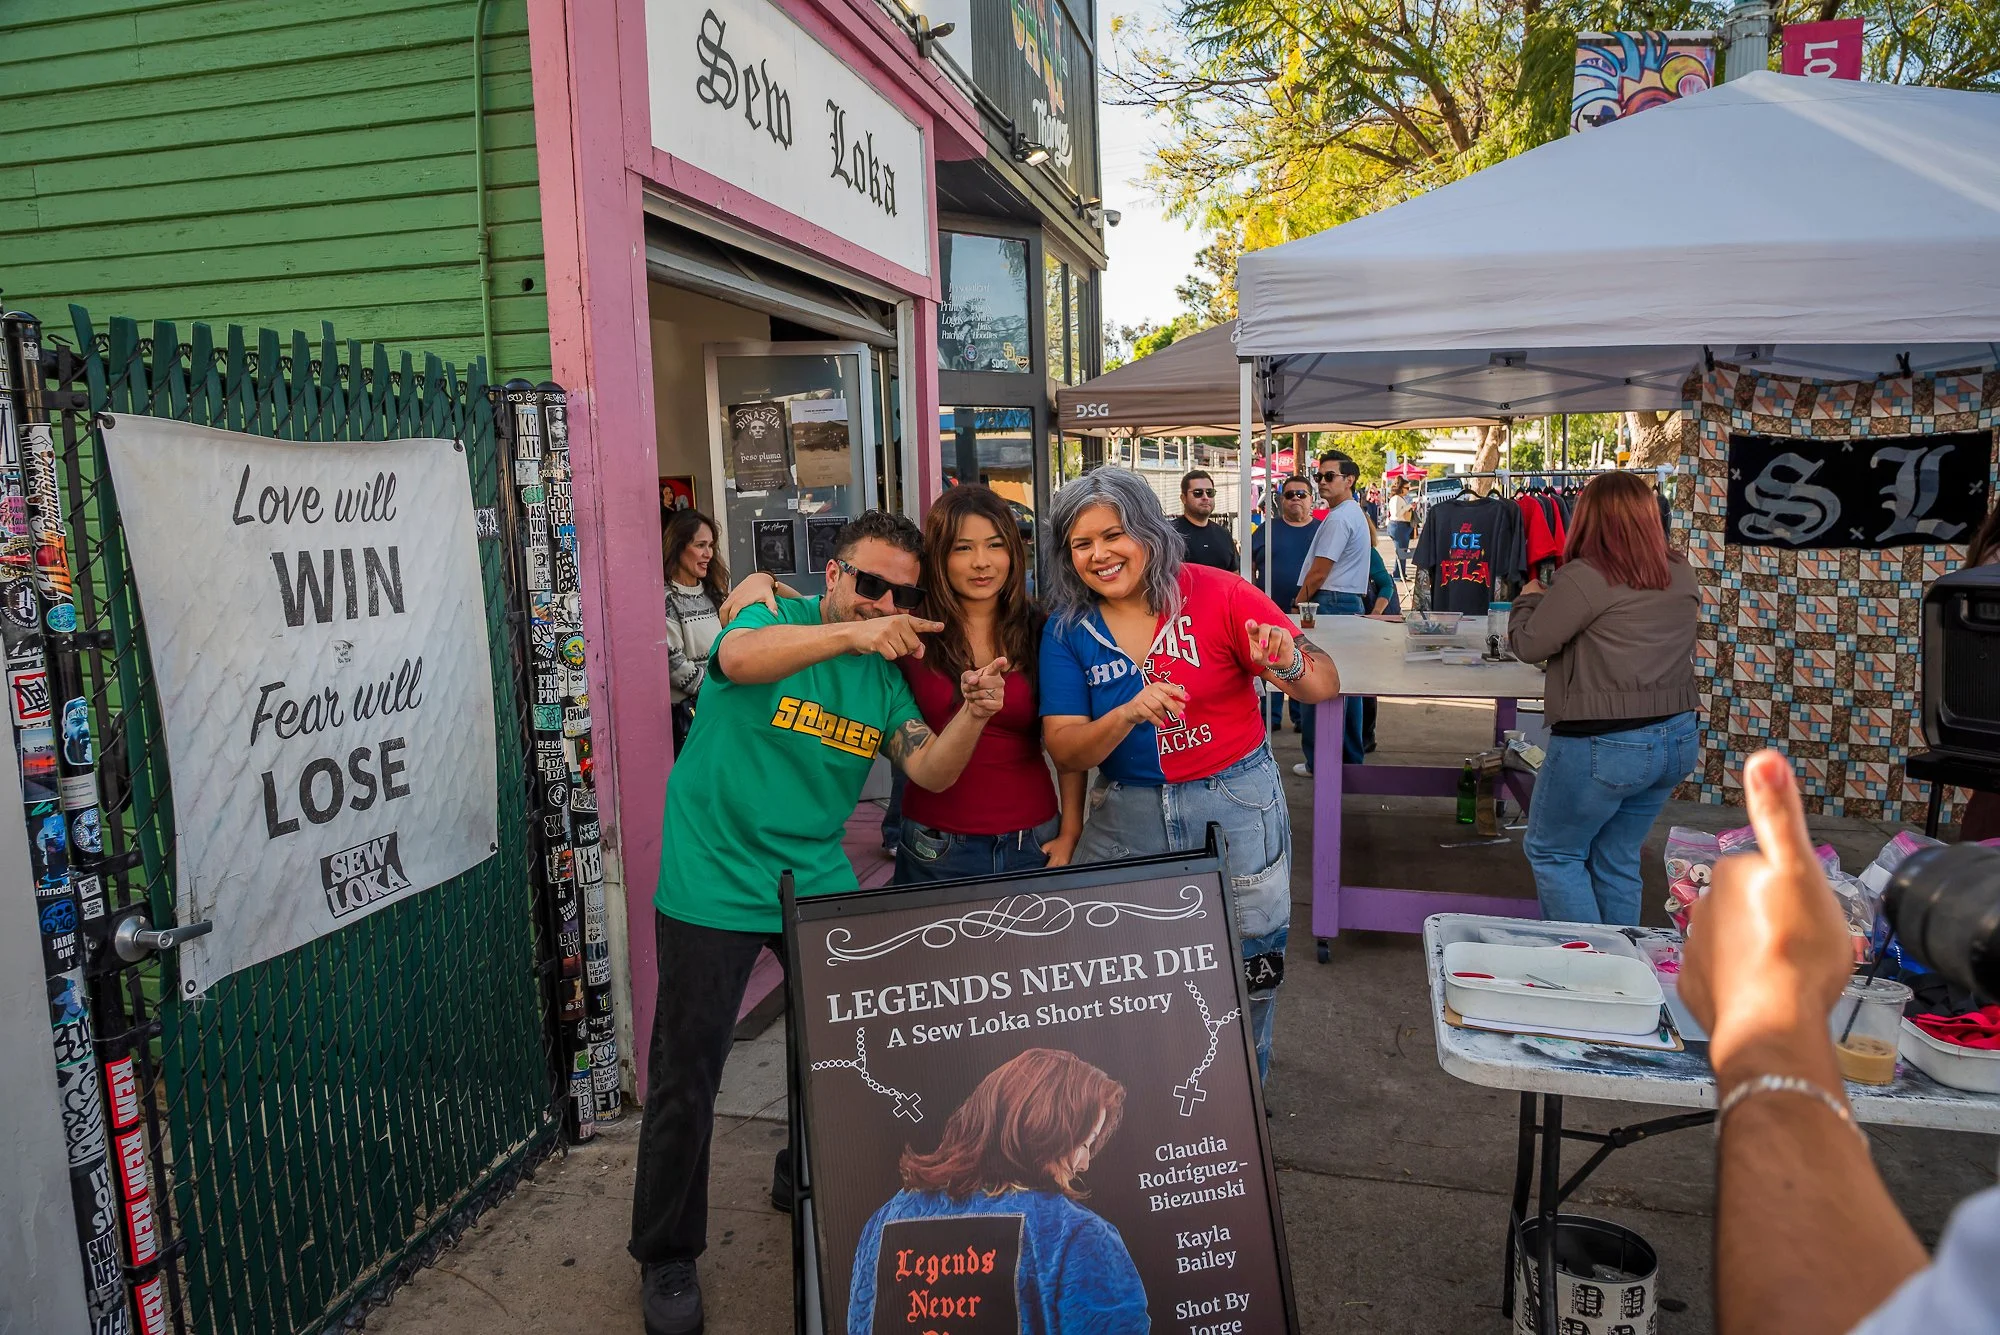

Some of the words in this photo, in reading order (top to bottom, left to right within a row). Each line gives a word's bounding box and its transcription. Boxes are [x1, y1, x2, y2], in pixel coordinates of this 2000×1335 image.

[696, 8, 793, 150] Sew
[826, 98, 898, 218] Loka
[940, 300, 963, 312] Prints
[942, 313, 964, 327] Logos
[1076, 403, 1109, 418] DSG
[741, 453, 757, 463] peso
[759, 452, 781, 462] pluma
[232, 464, 324, 527] Love
[334, 471, 397, 523] will
[1738, 451, 1841, 546] S
[1871, 443, 1968, 542] L
[1451, 532, 1482, 549] ICE
[271, 546, 405, 628] WIN
[250, 680, 346, 747] Fear
[352, 655, 423, 720] will
[261, 736, 411, 840] LOSE
[330, 836, 390, 886] SEW
[327, 863, 410, 918] LOKA
[826, 970, 1014, 1025] LEGENDS
[1019, 951, 1145, 996] NEVER
[1155, 943, 1219, 977] DIE
[886, 1028, 906, 1049] A
[911, 1019, 962, 1046] Sew
[969, 1009, 1034, 1038] Loka
[1035, 997, 1105, 1028] Short
[1108, 991, 1174, 1020] Story
[1155, 1136, 1228, 1162] Claudia
[1138, 1160, 1249, 1190] Rodríguez-
[1150, 1179, 1246, 1212] Biezunski
[1176, 1225, 1231, 1250] Kayla
[895, 1245, 997, 1285] Legends
[1176, 1250, 1237, 1274] Bailey
[907, 1289, 982, 1323] Never
[1175, 1297, 1222, 1320] Shot
[1225, 1292, 1250, 1312] By
